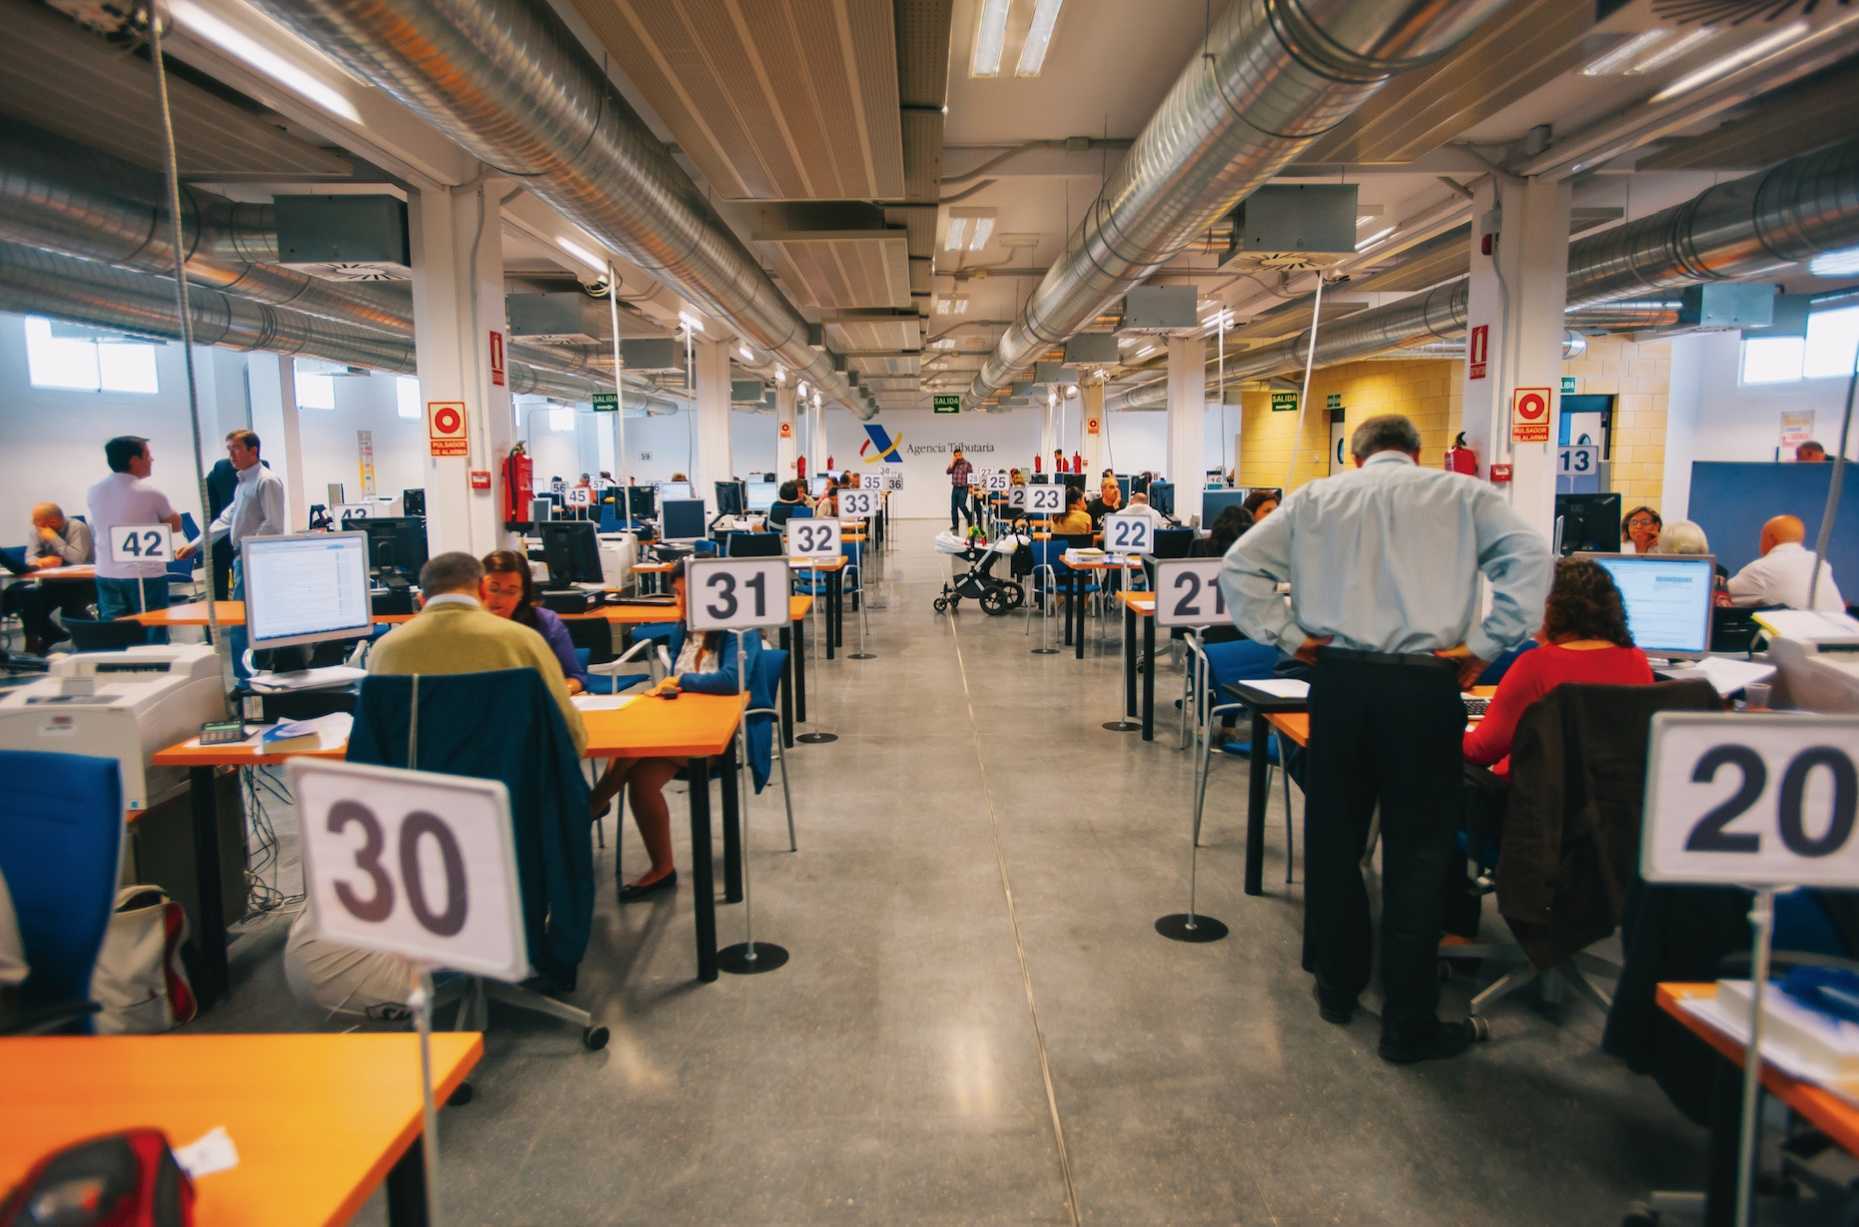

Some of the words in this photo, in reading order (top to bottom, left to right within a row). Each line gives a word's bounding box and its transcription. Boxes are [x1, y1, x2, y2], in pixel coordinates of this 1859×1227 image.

[1272, 394, 1296, 402] SALIDA
[907, 443, 946, 455] Agencia
[948, 442, 994, 452] Tributaria
[1560, 450, 1589, 471] 13
[864, 476, 880, 489] 35
[889, 479, 902, 489] 36
[990, 476, 1006, 488] 25
[569, 490, 586, 502] 45
[844, 494, 870, 513] 33
[1014, 490, 1024, 504] 2
[1034, 490, 1059, 508] 23
[797, 526, 833, 552] 32
[1115, 521, 1146, 546] 22
[122, 531, 163, 557] 42
[706, 572, 766, 620] 31
[1173, 571, 1226, 616] 21
[1684, 743, 1858, 858] 20
[326, 799, 469, 937] 30
